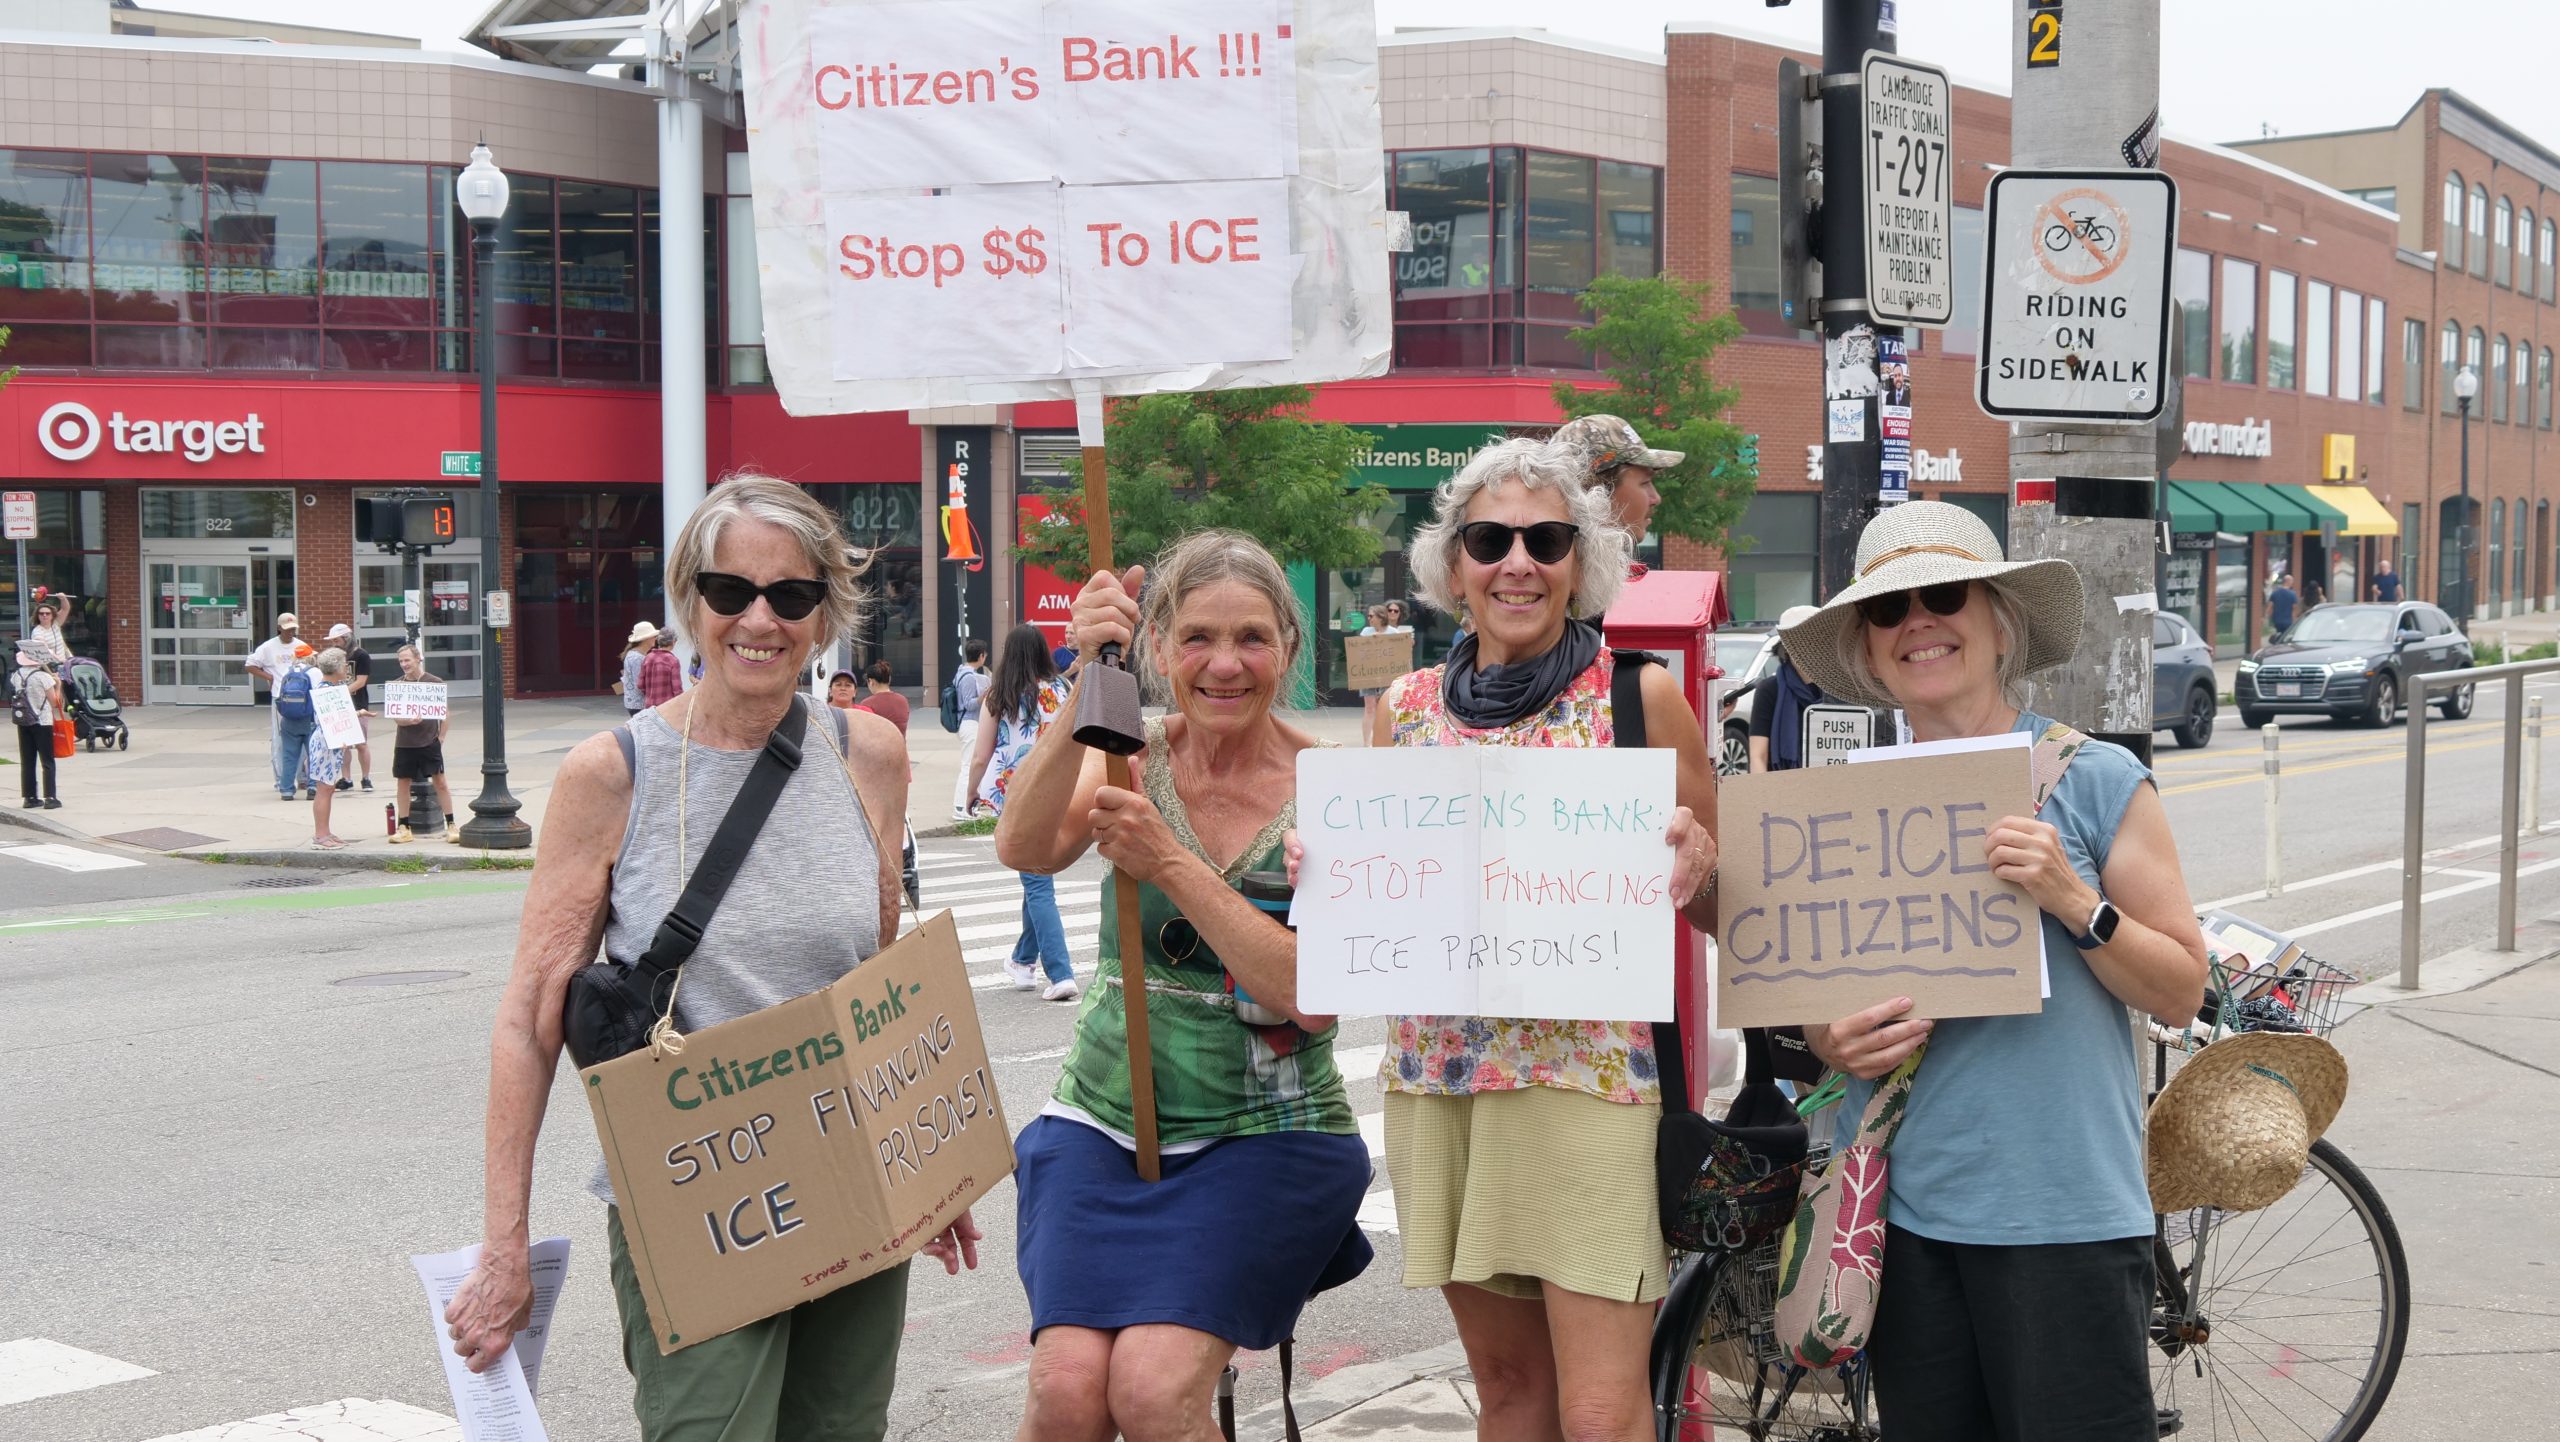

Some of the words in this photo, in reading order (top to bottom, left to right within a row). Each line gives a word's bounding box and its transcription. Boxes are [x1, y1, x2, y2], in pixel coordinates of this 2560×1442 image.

[2030, 13, 2060, 62] 2
[814, 56, 1041, 111] Citizen's
[1062, 35, 1200, 83] Bank
[1218, 32, 1262, 77] !!!
[1881, 74, 1934, 107] CAMBRIDGE
[1870, 100, 1909, 130] TRAFFIC
[1911, 110, 1946, 137] SIGNAL
[1871, 130, 1945, 202] T-297
[1879, 203, 1891, 226] TO
[1894, 205, 1930, 232] REPORT
[1932, 211, 1940, 234] A
[839, 231, 965, 288] Stop
[982, 224, 1048, 280] $$
[1086, 223, 1150, 268] To
[1169, 217, 1261, 265] ICE
[1878, 230, 1943, 260] MAINTENANCE
[1889, 258, 1932, 285] PROBLEM
[1881, 287, 1897, 305] CALL
[2026, 295, 2127, 318] RIDING
[2056, 327, 2095, 350] ON
[1998, 357, 2148, 383] SIDEWALK
[109, 411, 265, 463] target
[2185, 421, 2219, 453] one
[2220, 417, 2272, 457] medical
[445, 455, 470, 472] WHITE
[1913, 447, 1962, 482] Bank
[18, 493, 33, 502] ZONE
[852, 495, 900, 530] 822
[6, 515, 34, 523] STOPPING
[206, 518, 233, 532] 822
[433, 507, 454, 536] 13
[1038, 594, 1071, 610] ATM
[1350, 664, 1389, 677] Citizens
[386, 684, 423, 694] CITIZENS
[426, 685, 446, 694] BANK
[386, 693, 403, 702] STOP
[407, 694, 446, 703] FINANCING
[386, 704, 402, 716] ICE
[406, 704, 447, 717] PRISONS
[1823, 720, 1854, 734] PUSH
[1816, 736, 1861, 750] BUTTON
[1323, 790, 1527, 832] CITIZENS
[1550, 796, 1665, 836] BANK:
[1759, 801, 1989, 888] DE-ICE
[1329, 854, 1443, 902] STOP
[1482, 856, 1664, 906] FINANCING
[1726, 889, 2022, 966] CITIZENS
[1342, 933, 1416, 975] ICE
[1441, 928, 1621, 972] PRISONS!
[1774, 1034, 1807, 1047] planet
[665, 1030, 845, 1111] Citizens
[665, 1113, 776, 1186] STOP
[810, 1013, 956, 1137] FINANCING
[704, 1181, 806, 1256] ICE
[878, 1066, 996, 1190] PRISONS!
[801, 1257, 850, 1288] Invest
[859, 1249, 875, 1262] in
[935, 1197, 947, 1213] not
